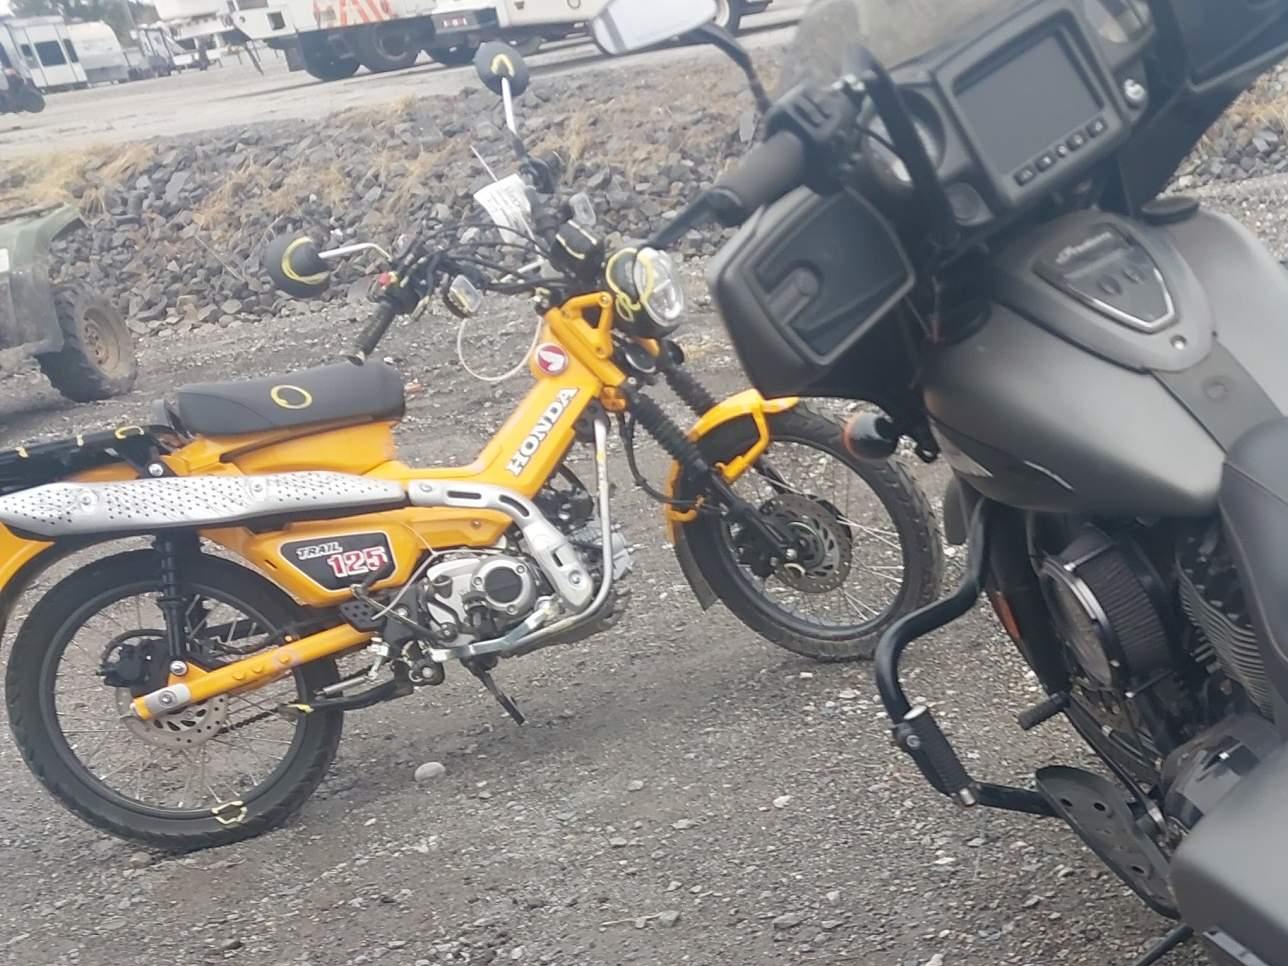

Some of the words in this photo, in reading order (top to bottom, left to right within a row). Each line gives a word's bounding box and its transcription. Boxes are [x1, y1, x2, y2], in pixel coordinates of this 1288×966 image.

[504, 387, 579, 477] HONDA
[296, 541, 343, 560] TRAIL
[327, 546, 387, 578] 125
